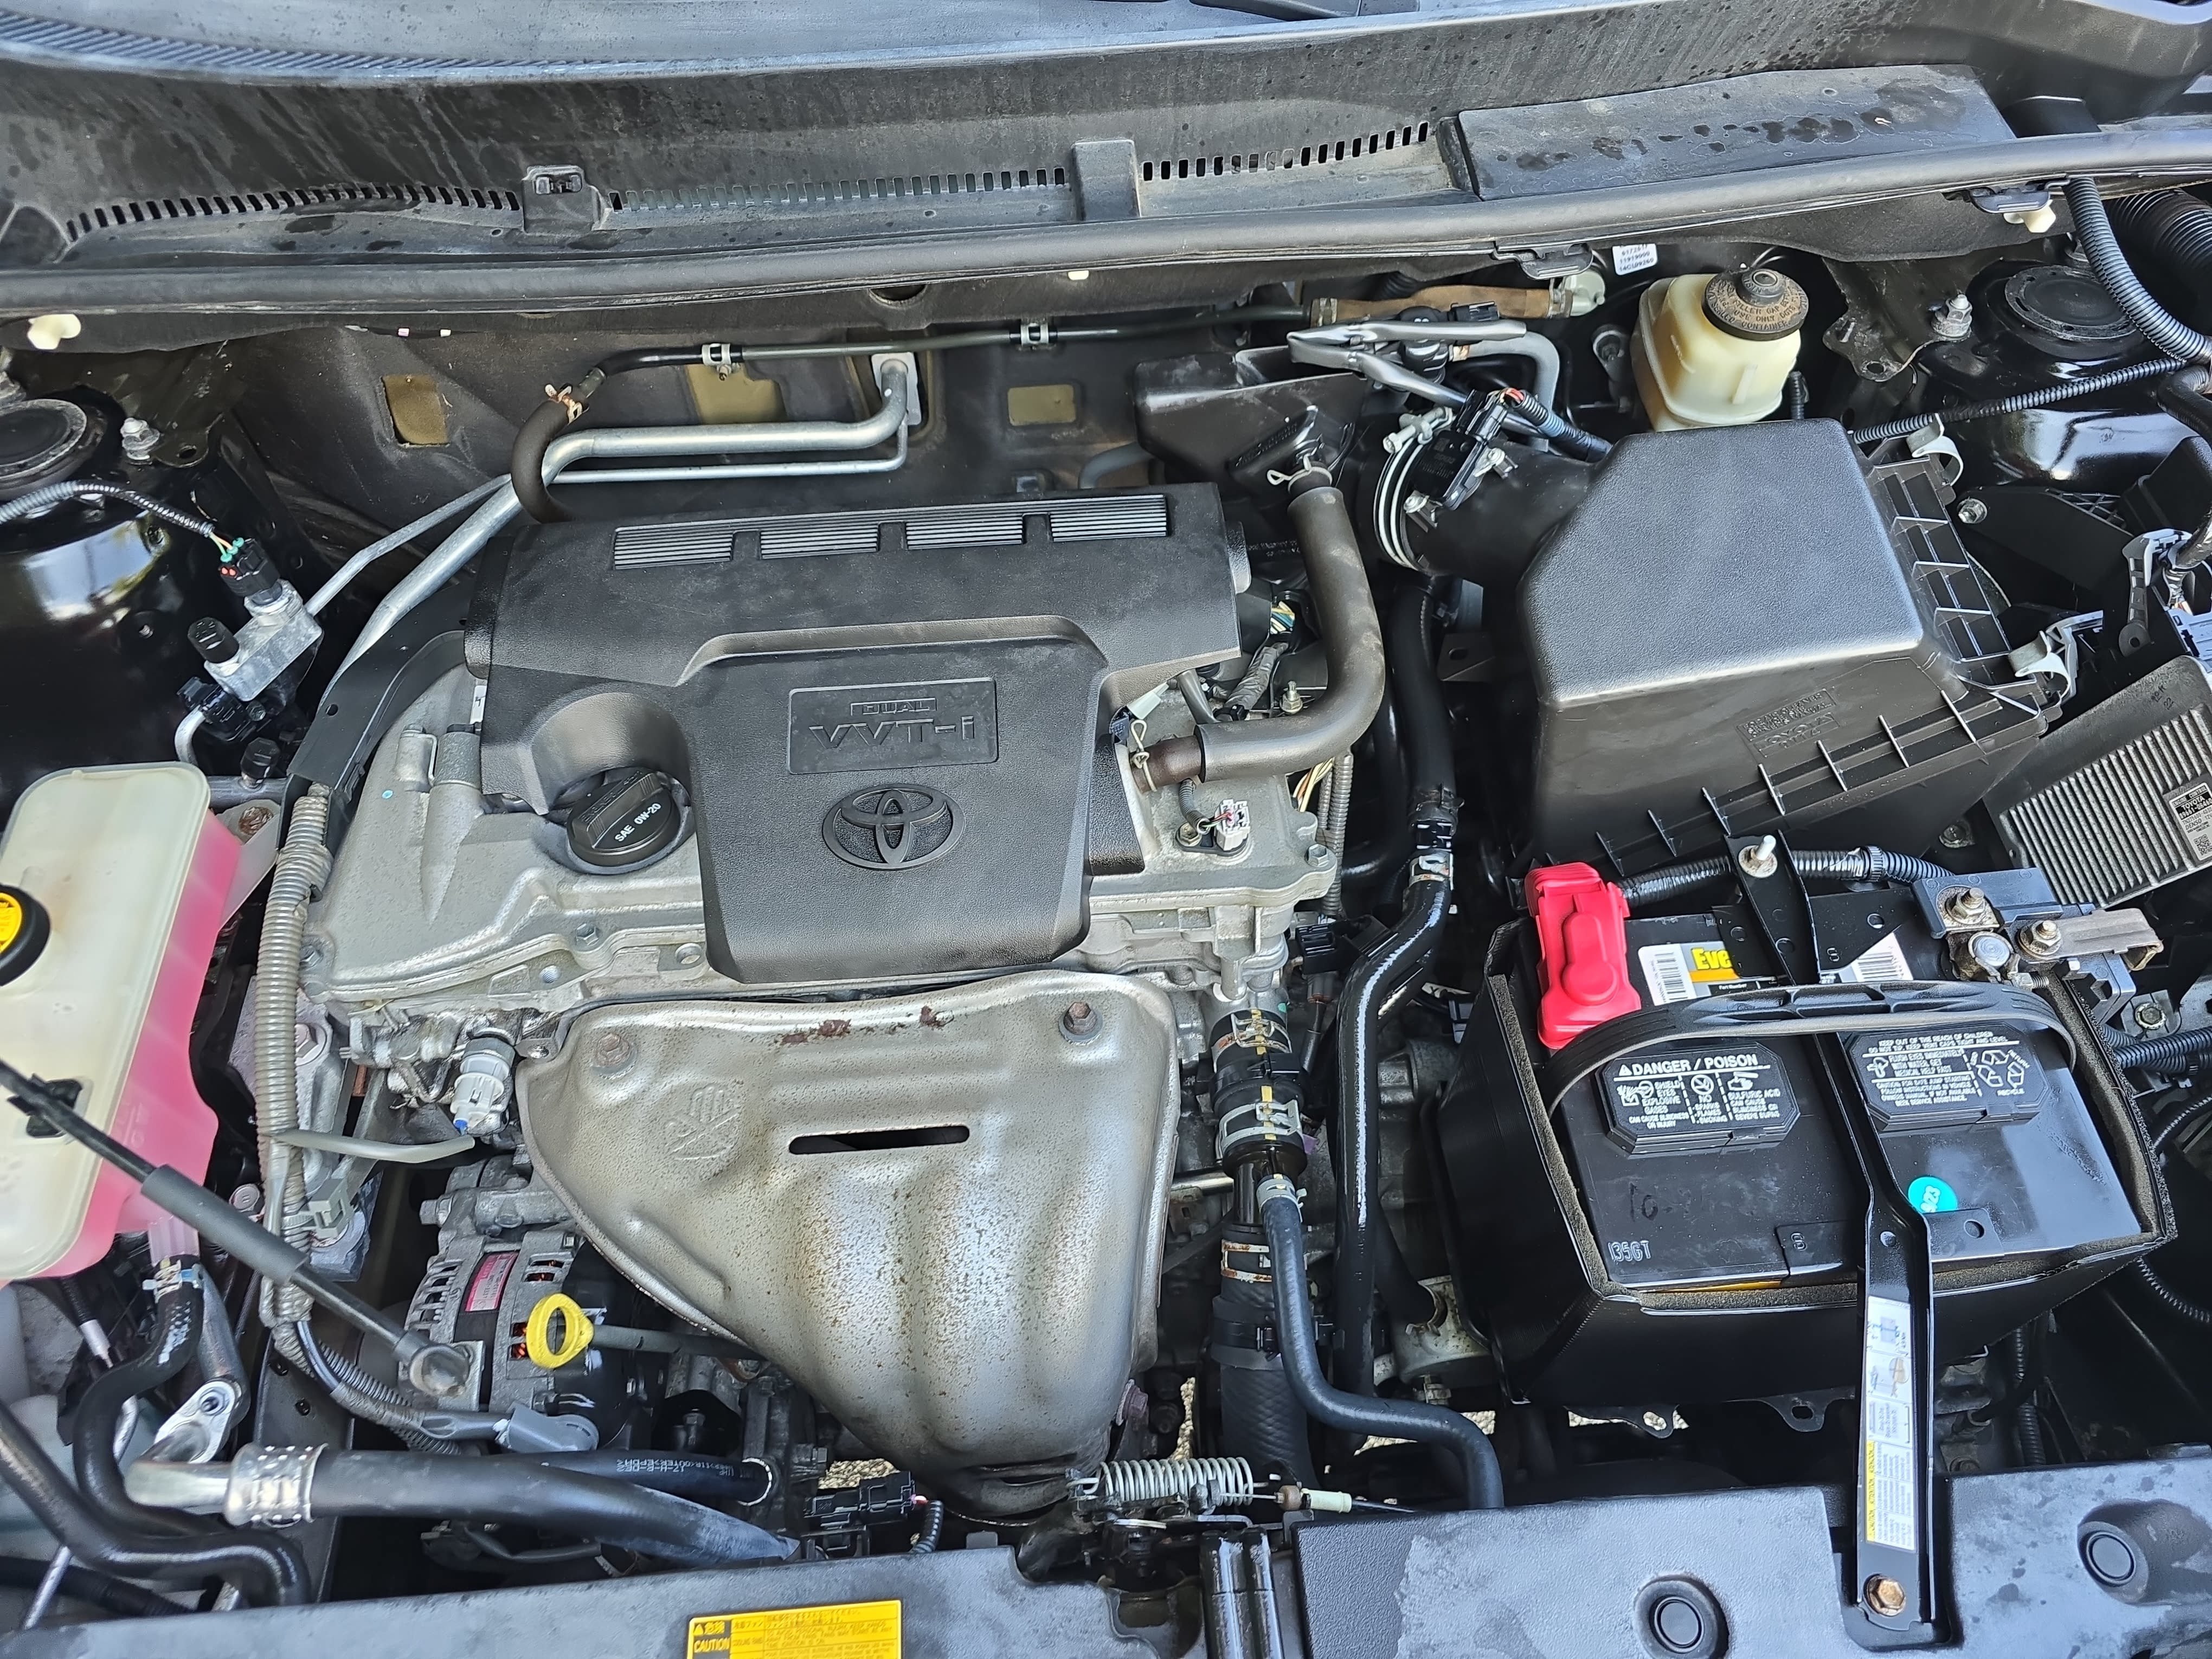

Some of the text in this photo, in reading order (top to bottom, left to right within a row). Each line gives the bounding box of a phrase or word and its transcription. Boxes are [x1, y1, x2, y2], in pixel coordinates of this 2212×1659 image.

[862, 699, 931, 716] DUAL
[808, 715, 975, 750] VVT-i
[2181, 795, 2205, 811] TOYOTA
[614, 802, 662, 842] SAE 0W-20
[2185, 818, 2202, 830] DENSO
[1631, 1053, 1758, 1076] DANGER / POISON
[1654, 1080, 1681, 1090] SHIELD
[1656, 1088, 1676, 1097] EYES
[1698, 1094, 1713, 1103] NO
[1727, 1088, 1781, 1101] SULFURIC ACID
[1641, 1095, 1681, 1107] EXPLOSIVE
[1644, 1105, 1669, 1115] GASES
[694, 1637, 730, 1654] CAUTION
